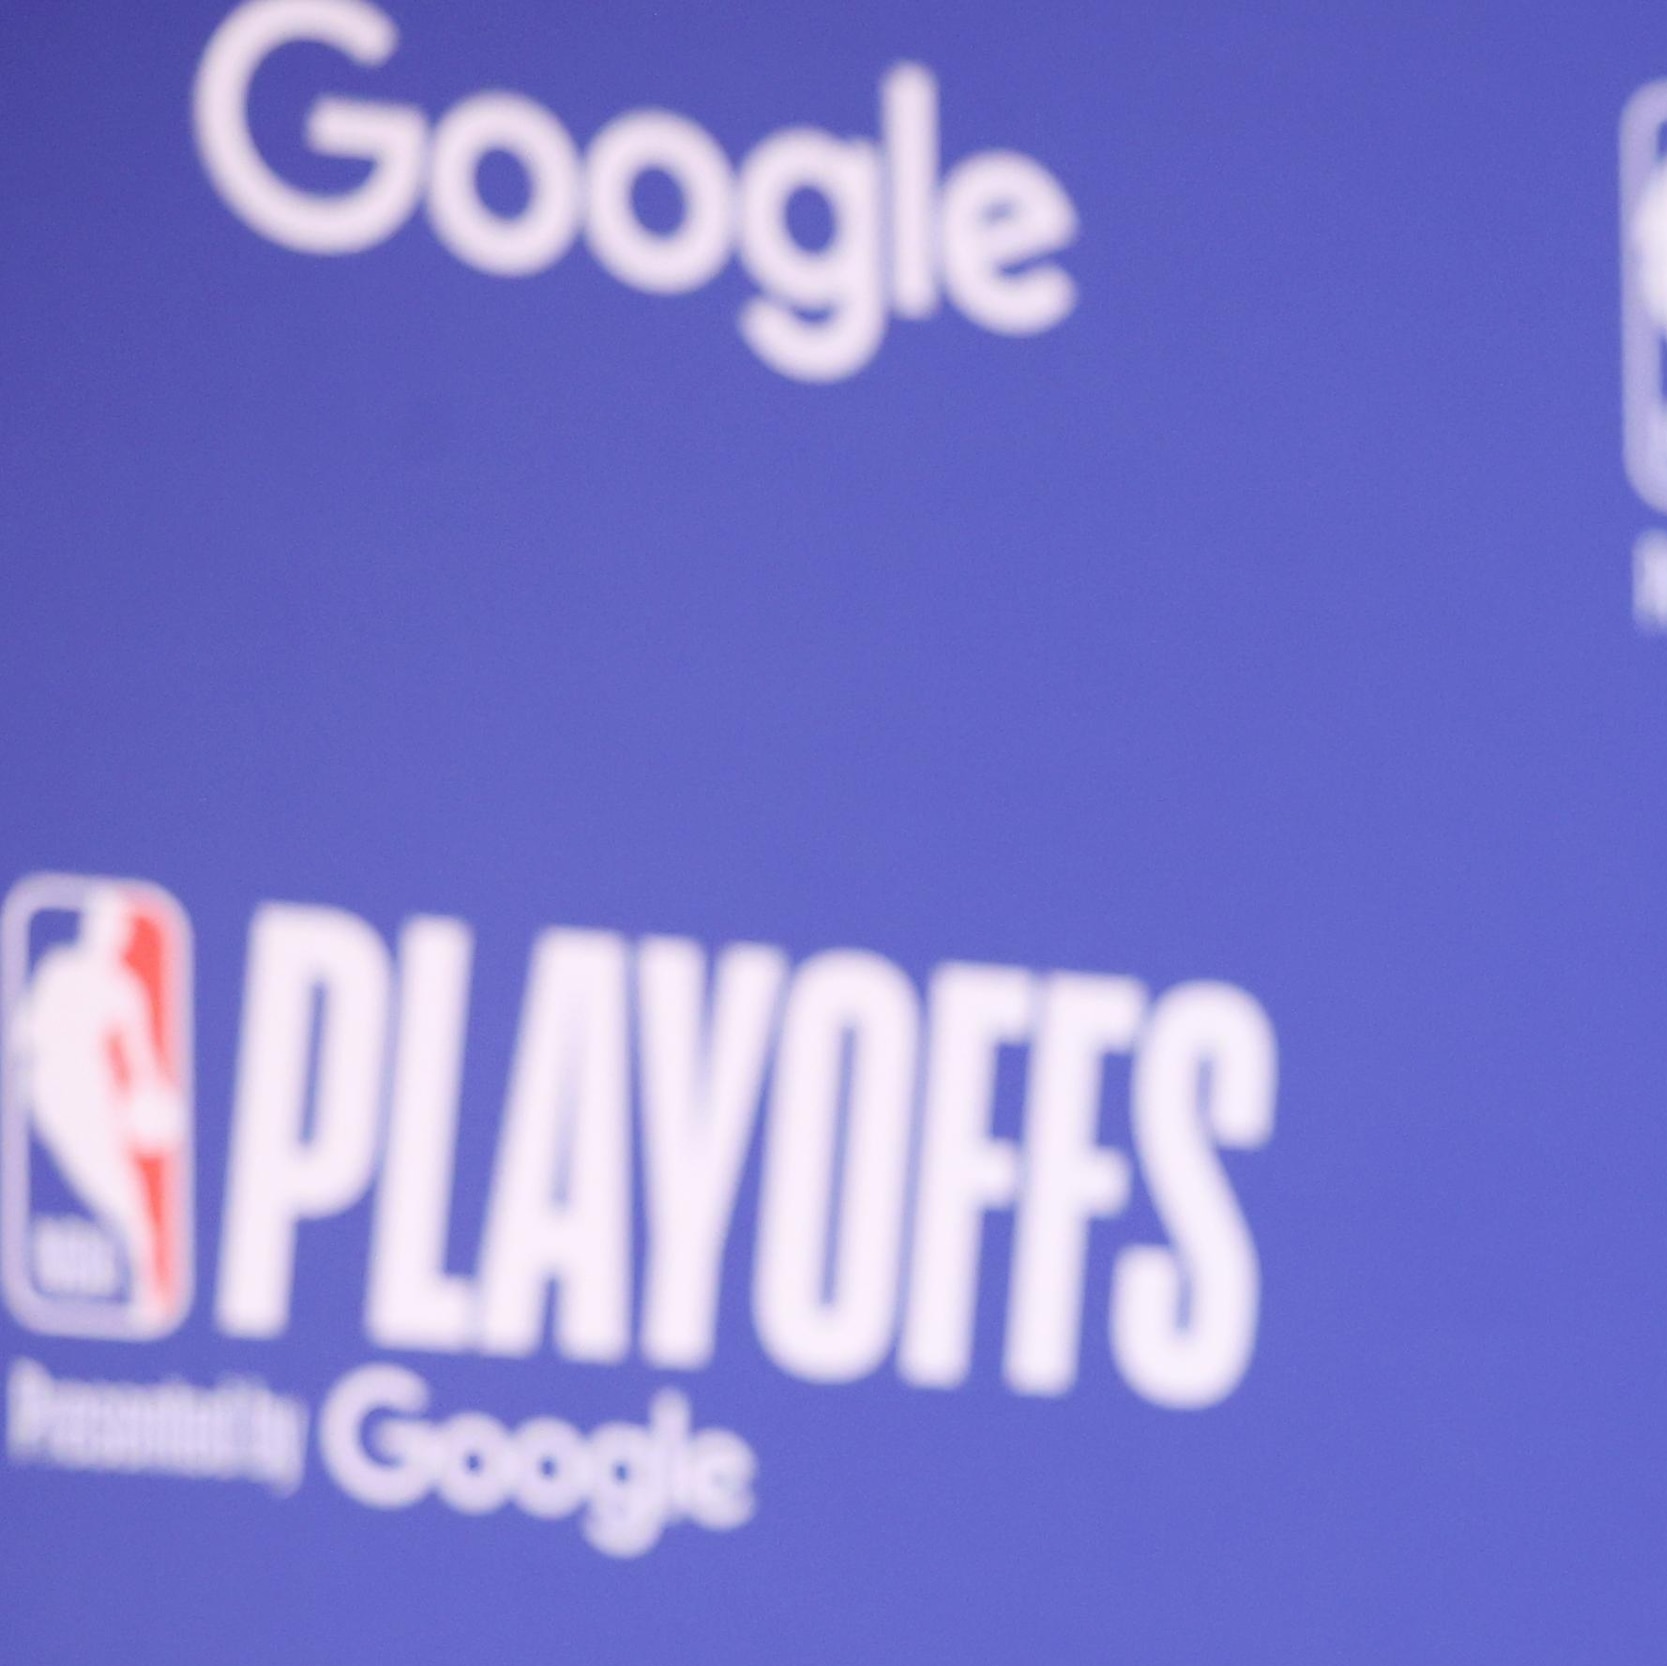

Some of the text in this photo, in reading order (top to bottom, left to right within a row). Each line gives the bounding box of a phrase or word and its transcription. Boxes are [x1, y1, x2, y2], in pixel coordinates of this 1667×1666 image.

[192, 0, 1082, 385] Google
[212, 898, 1281, 1410] PLAYOFFS
[318, 1362, 760, 1560] Google
